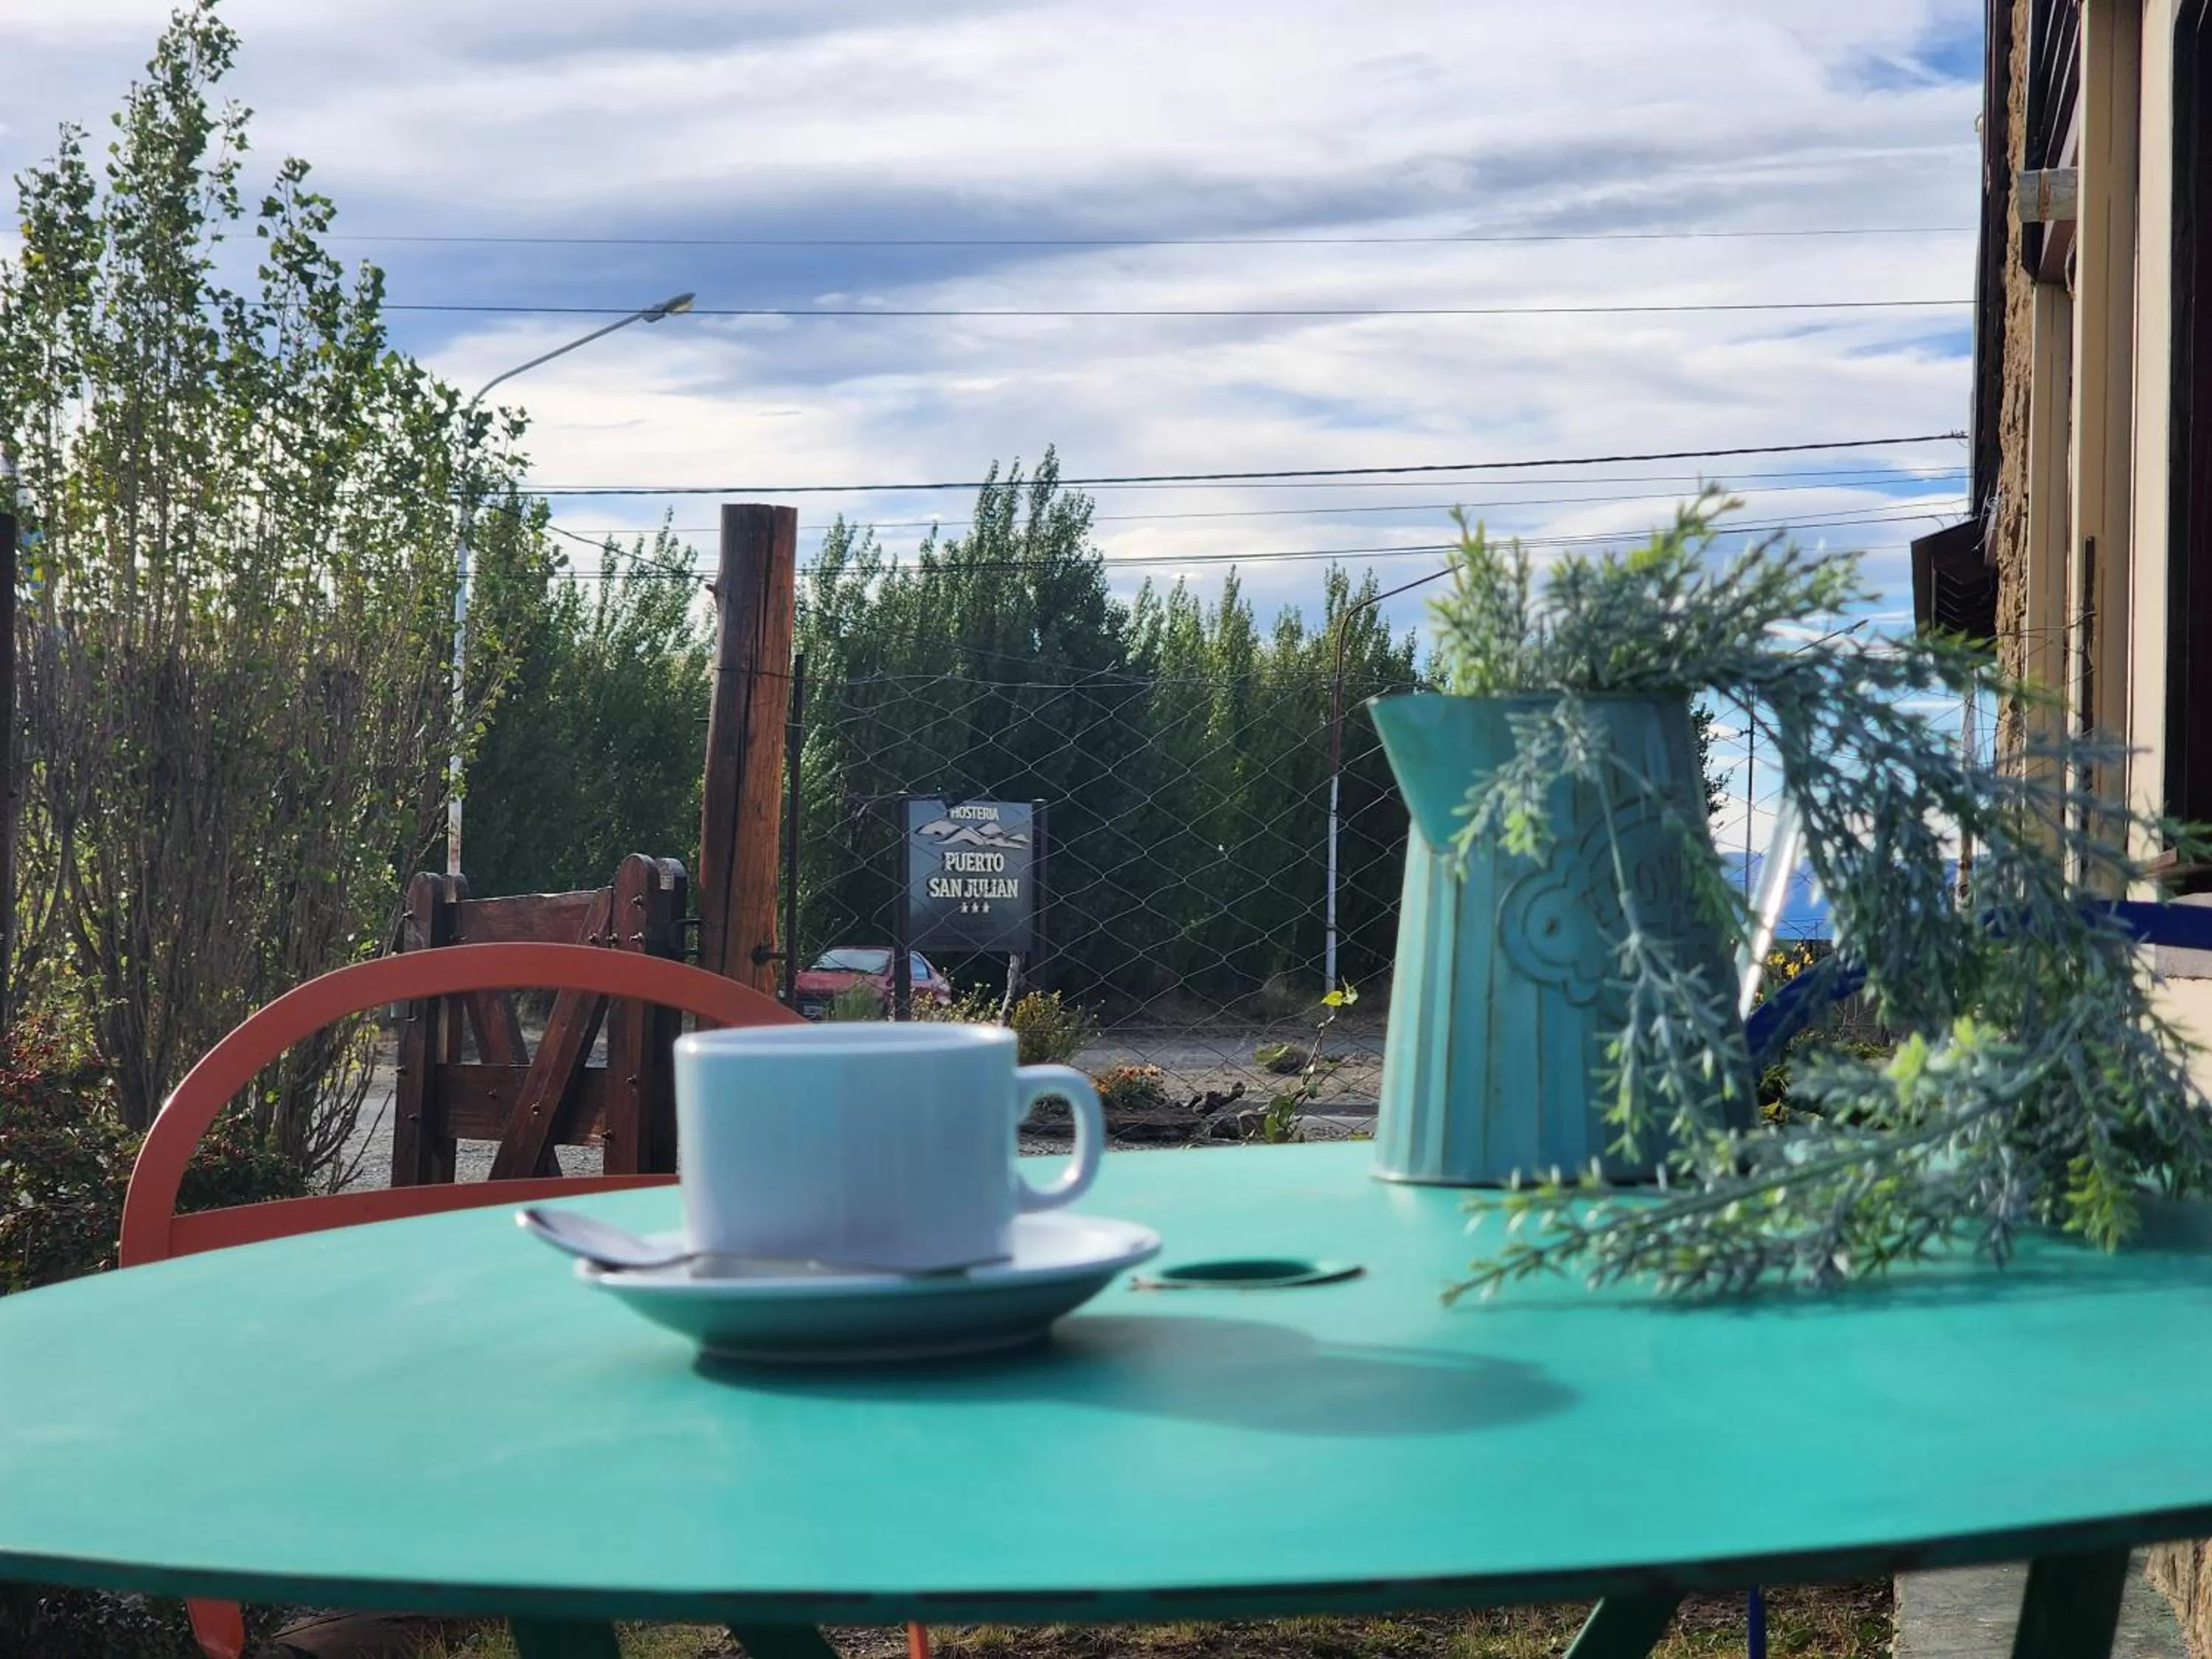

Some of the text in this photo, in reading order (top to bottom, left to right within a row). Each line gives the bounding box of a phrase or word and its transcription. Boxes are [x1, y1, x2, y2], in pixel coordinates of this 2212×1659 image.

[944, 852, 1004, 872] PUERTO
[928, 877, 1018, 898] SAN JULIAN
